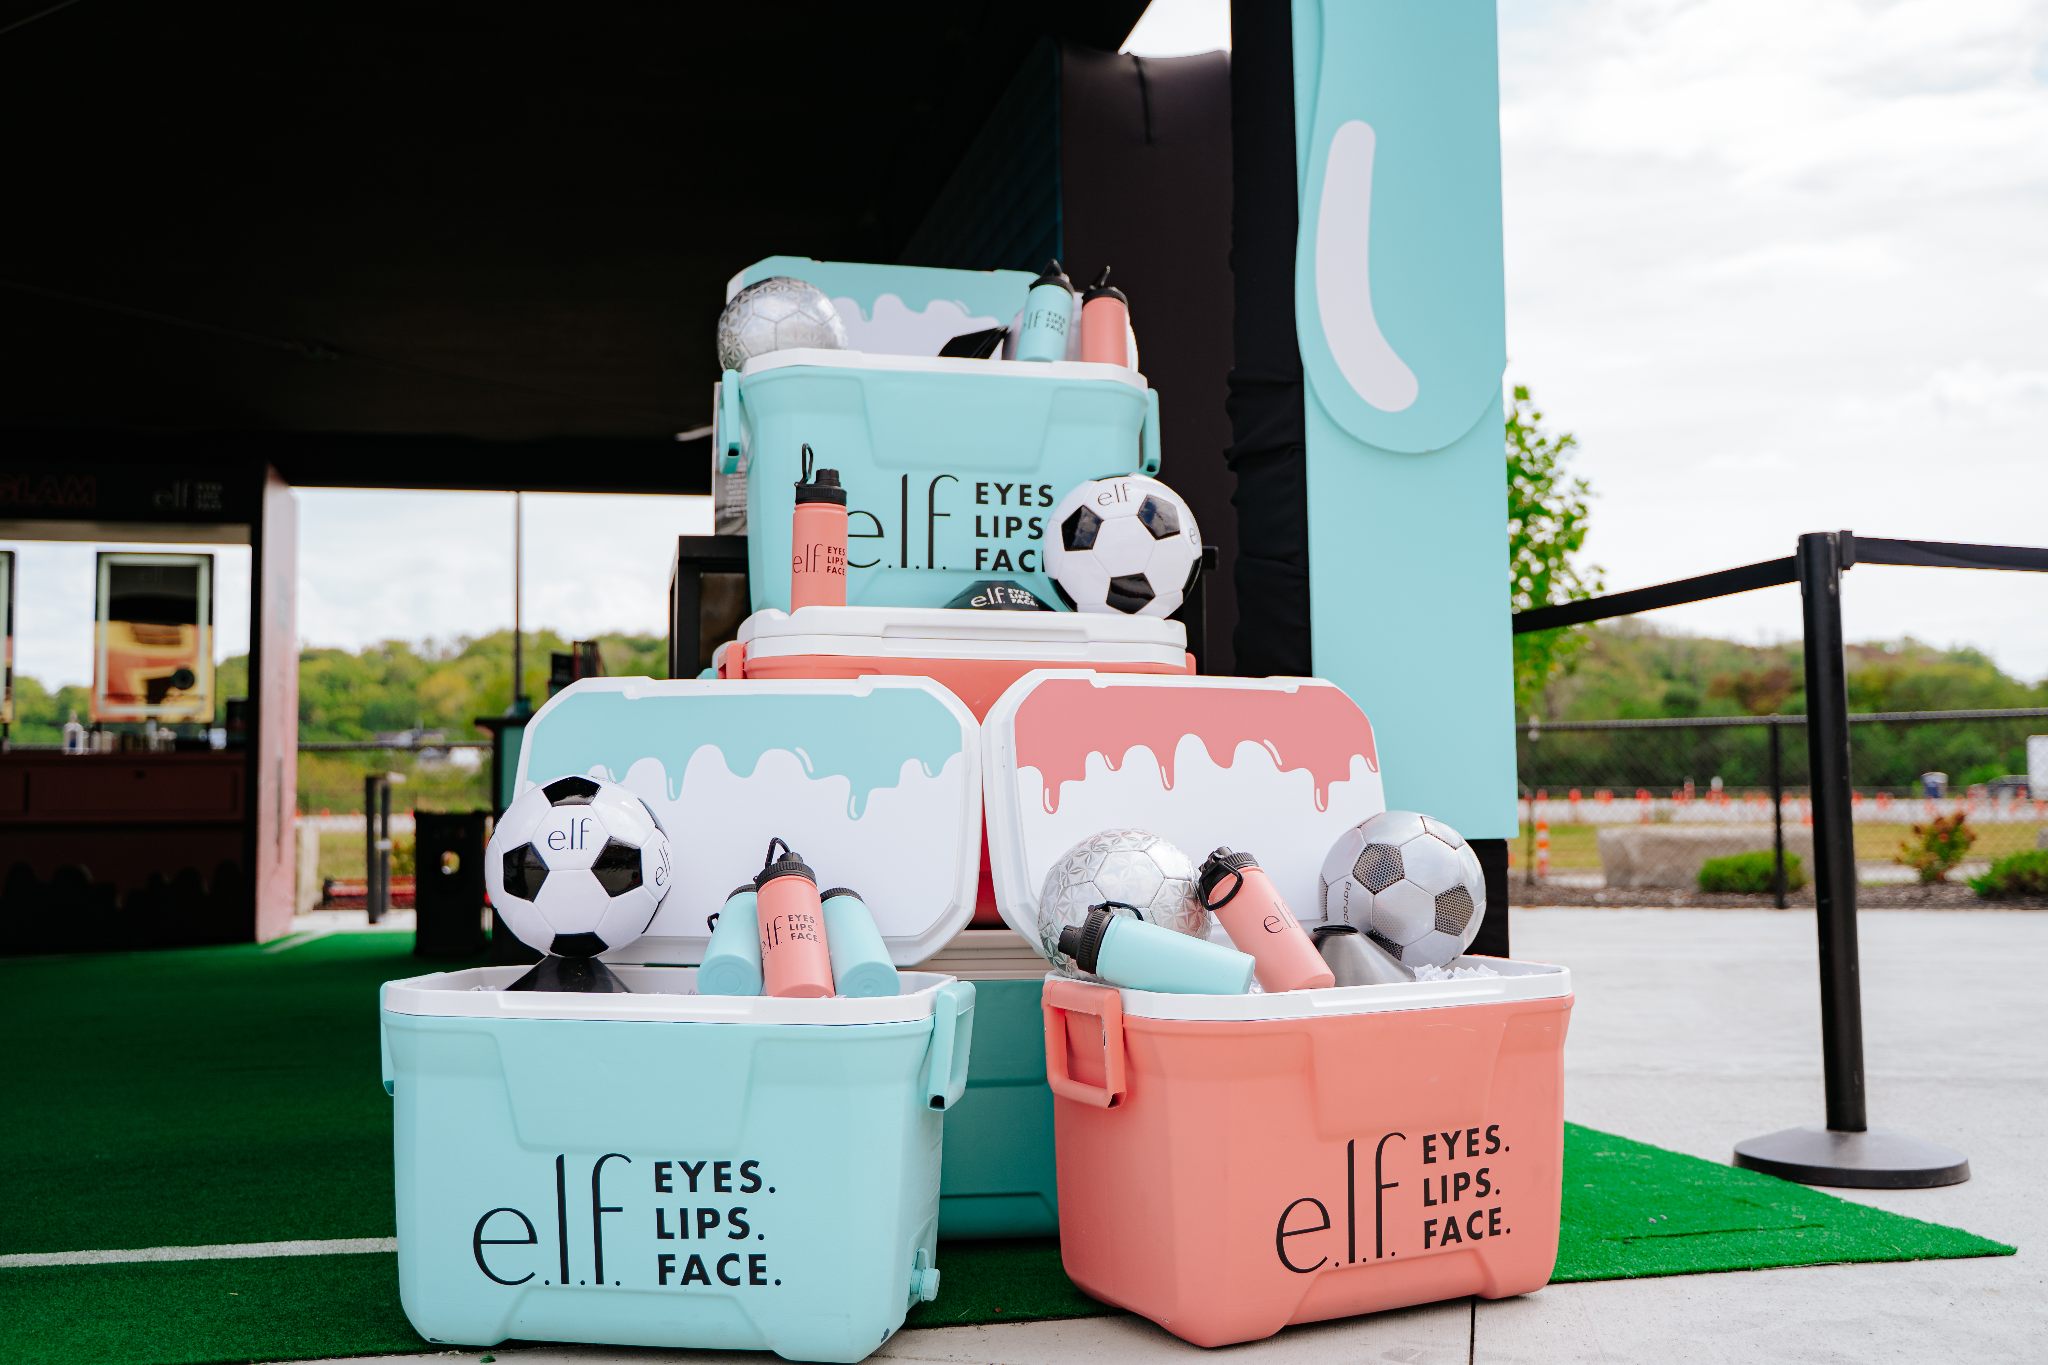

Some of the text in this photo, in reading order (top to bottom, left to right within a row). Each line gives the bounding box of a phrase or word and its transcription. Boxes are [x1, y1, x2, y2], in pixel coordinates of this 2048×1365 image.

[975, 548, 1046, 573] FAC
[1422, 1124, 1510, 1164] EYES.
[654, 1159, 777, 1193] EYES.
[1423, 1167, 1501, 1208] LIPS.
[472, 1152, 633, 1286] e.l.f.
[655, 1206, 766, 1240] LIPS.
[1276, 1132, 1407, 1274] e.l.f.
[1423, 1206, 1511, 1250] FACE.
[657, 1252, 783, 1286] FACE.
